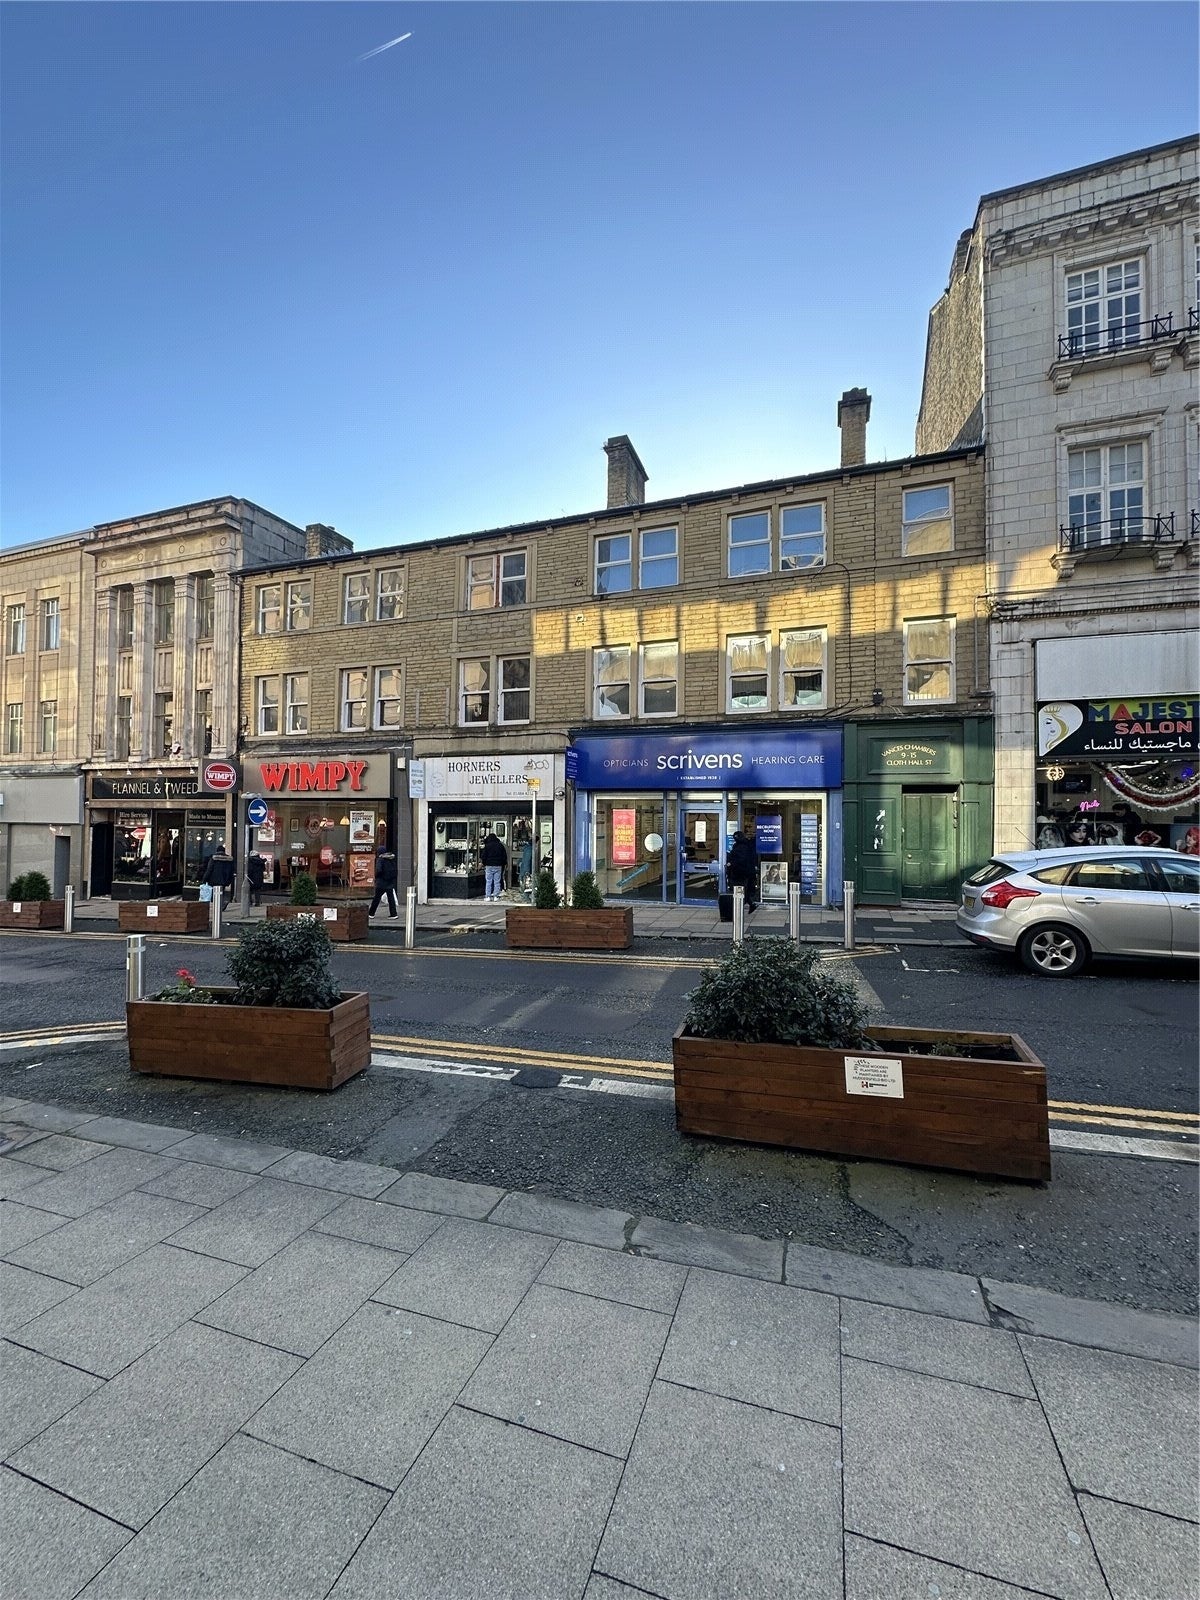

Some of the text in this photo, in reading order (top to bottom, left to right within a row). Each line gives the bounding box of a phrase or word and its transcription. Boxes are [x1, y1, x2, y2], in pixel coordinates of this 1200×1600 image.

[1115, 721, 1193, 735] SALON
[904, 744, 937, 756] CHAMBERS
[1084, 738, 1123, 750] للنساء
[1129, 736, 1191, 752] ماجستيك
[604, 749, 826, 770] OPTICIANS scrivens HEARING CARE
[449, 760, 502, 774] HORNERS
[206, 772, 235, 780] WIMPY
[260, 761, 367, 792] WIMPY
[469, 773, 529, 785] JEWELLERS
[113, 782, 199, 794] FLANNEL & TWEED
